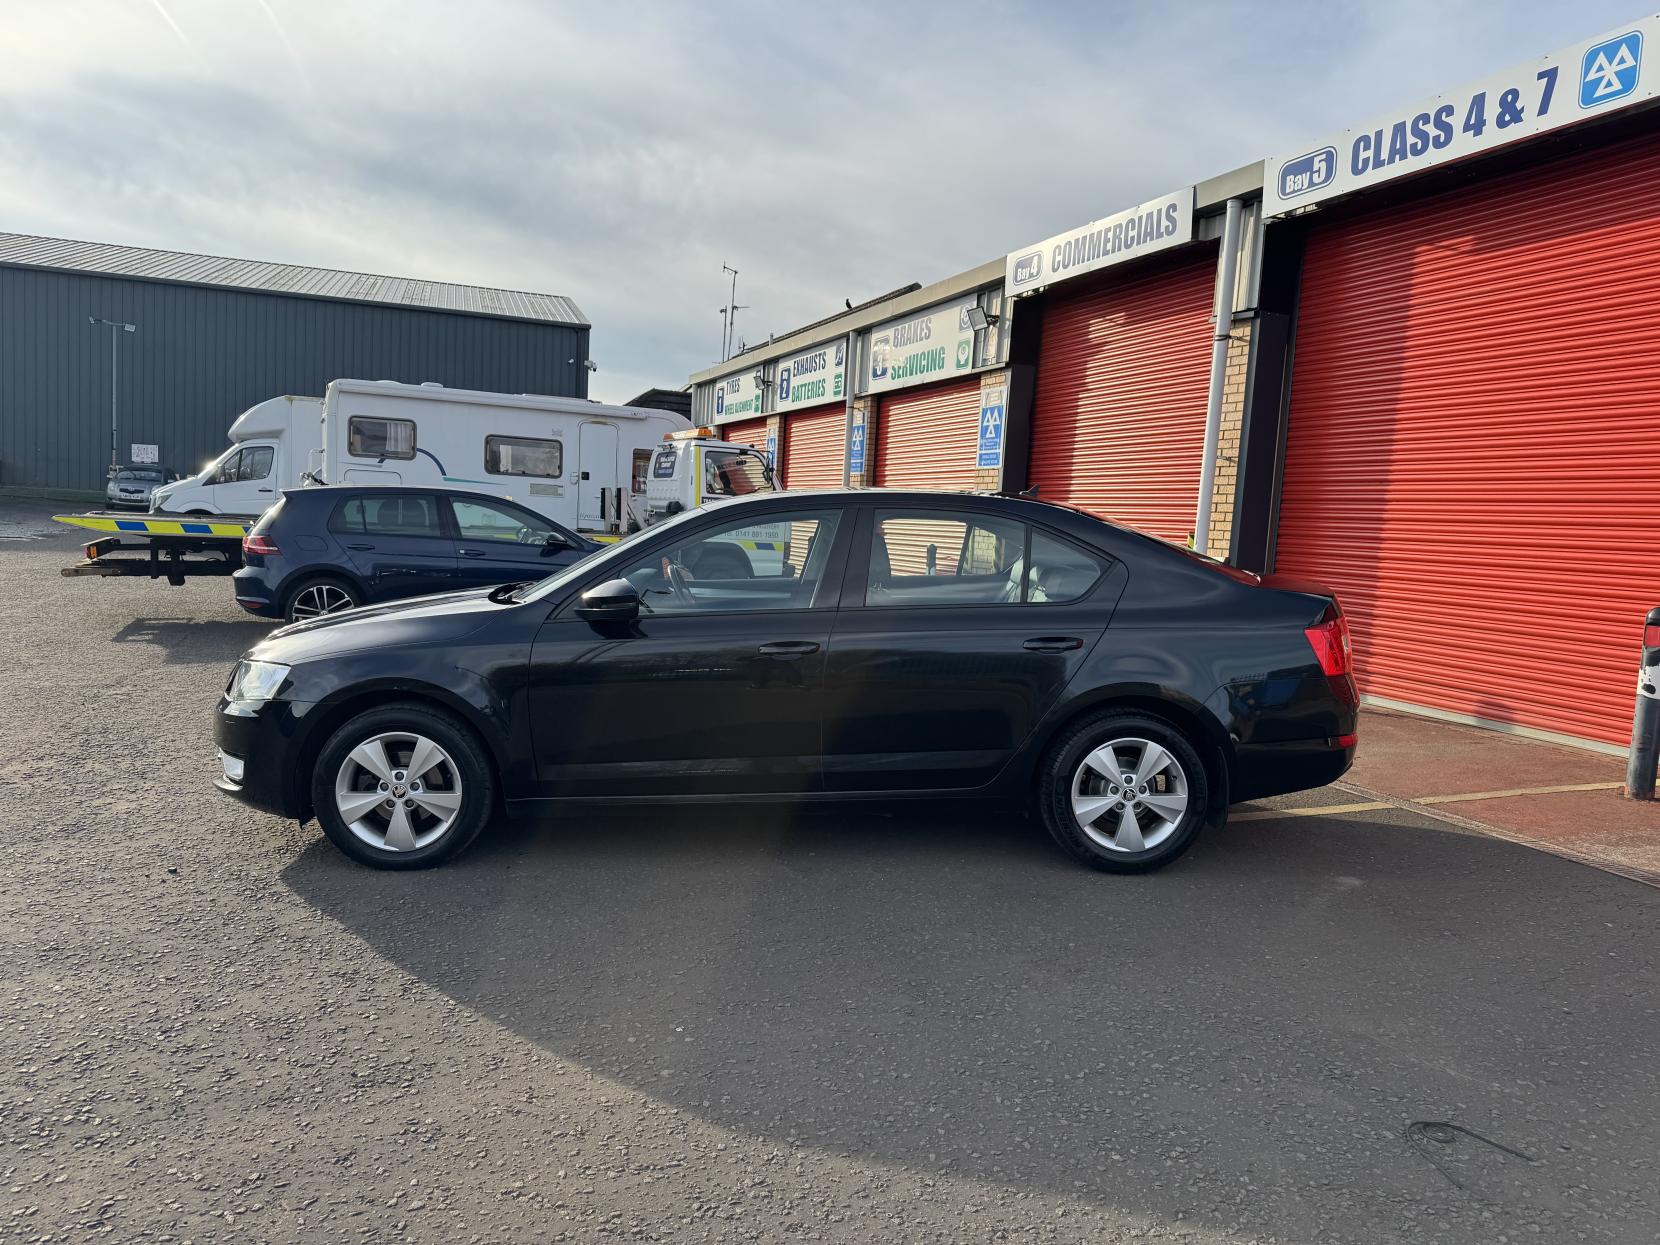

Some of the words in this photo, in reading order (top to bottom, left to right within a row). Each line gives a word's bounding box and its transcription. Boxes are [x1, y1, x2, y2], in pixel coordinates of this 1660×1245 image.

[1351, 105, 1454, 176] CLASS
[1462, 91, 1487, 138] 4
[1495, 88, 1525, 130] &
[1536, 66, 1560, 117] 7
[1285, 171, 1310, 194] Bay
[1311, 154, 1327, 184] 5
[1052, 203, 1177, 272] COMMERCIALS
[1016, 265, 1031, 281] Bay
[1029, 254, 1038, 276] 4
[893, 317, 932, 348] BRAKES
[793, 351, 826, 377] EXHAUSTS
[876, 354, 883, 375] 3
[891, 347, 945, 380] SERVICING
[726, 377, 740, 395] TYRES
[781, 380, 788, 398] 2
[791, 378, 826, 403] BATTERIES
